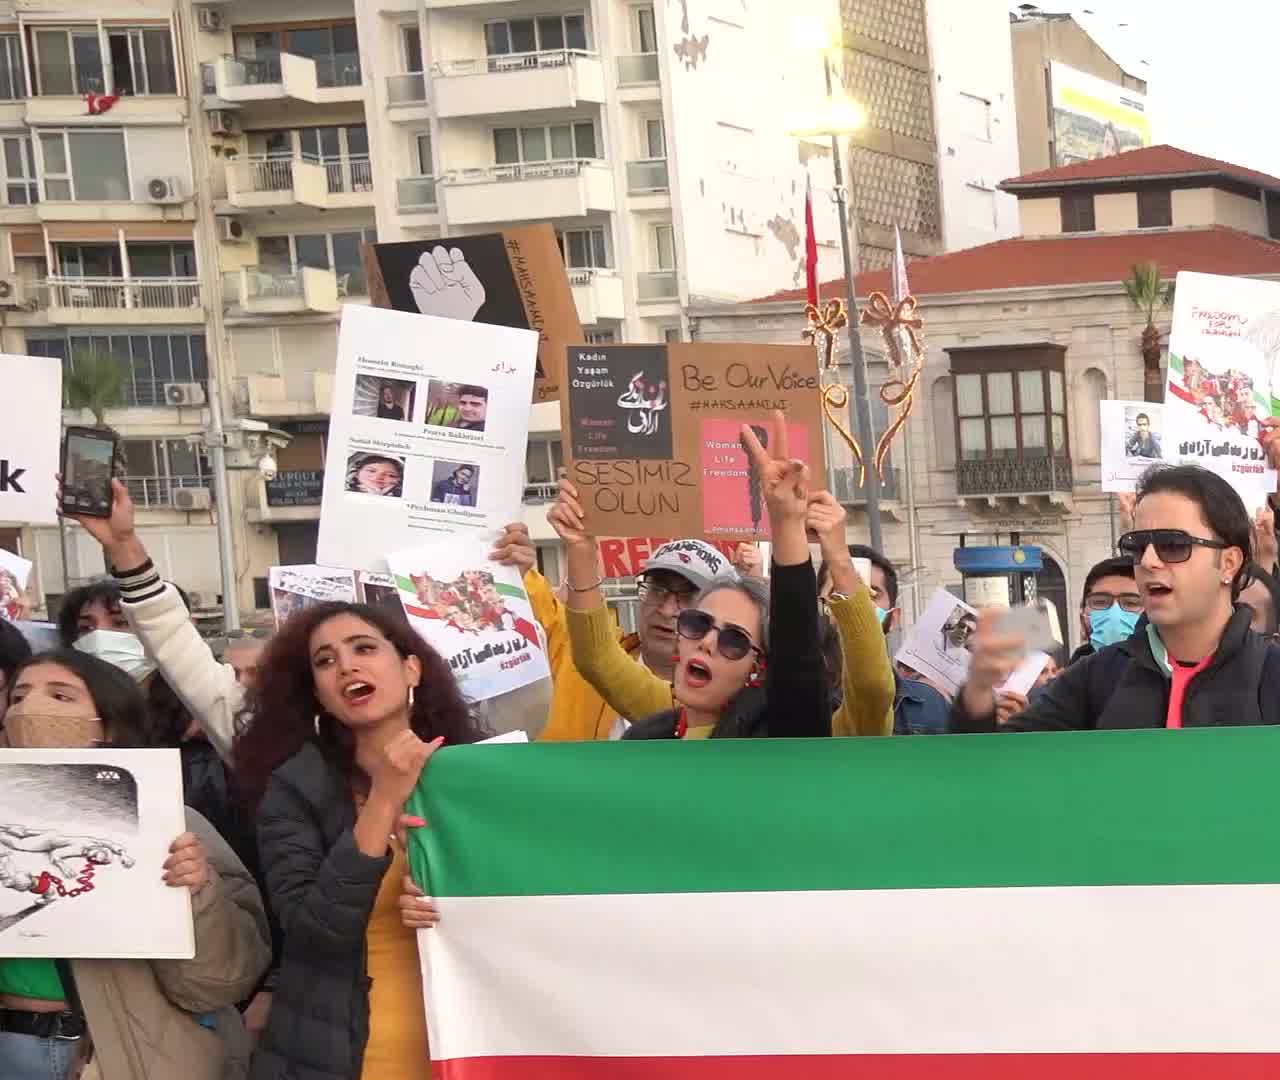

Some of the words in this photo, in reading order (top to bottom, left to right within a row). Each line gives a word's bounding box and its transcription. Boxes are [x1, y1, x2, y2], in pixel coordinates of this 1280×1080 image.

[681, 364, 718, 391] Be
[725, 363, 767, 389] Our
[767, 363, 818, 391] Voice
[705, 441, 742, 449] Woman
[594, 487, 680, 516] OLUN
[654, 540, 723, 575] CHAMPIONS
